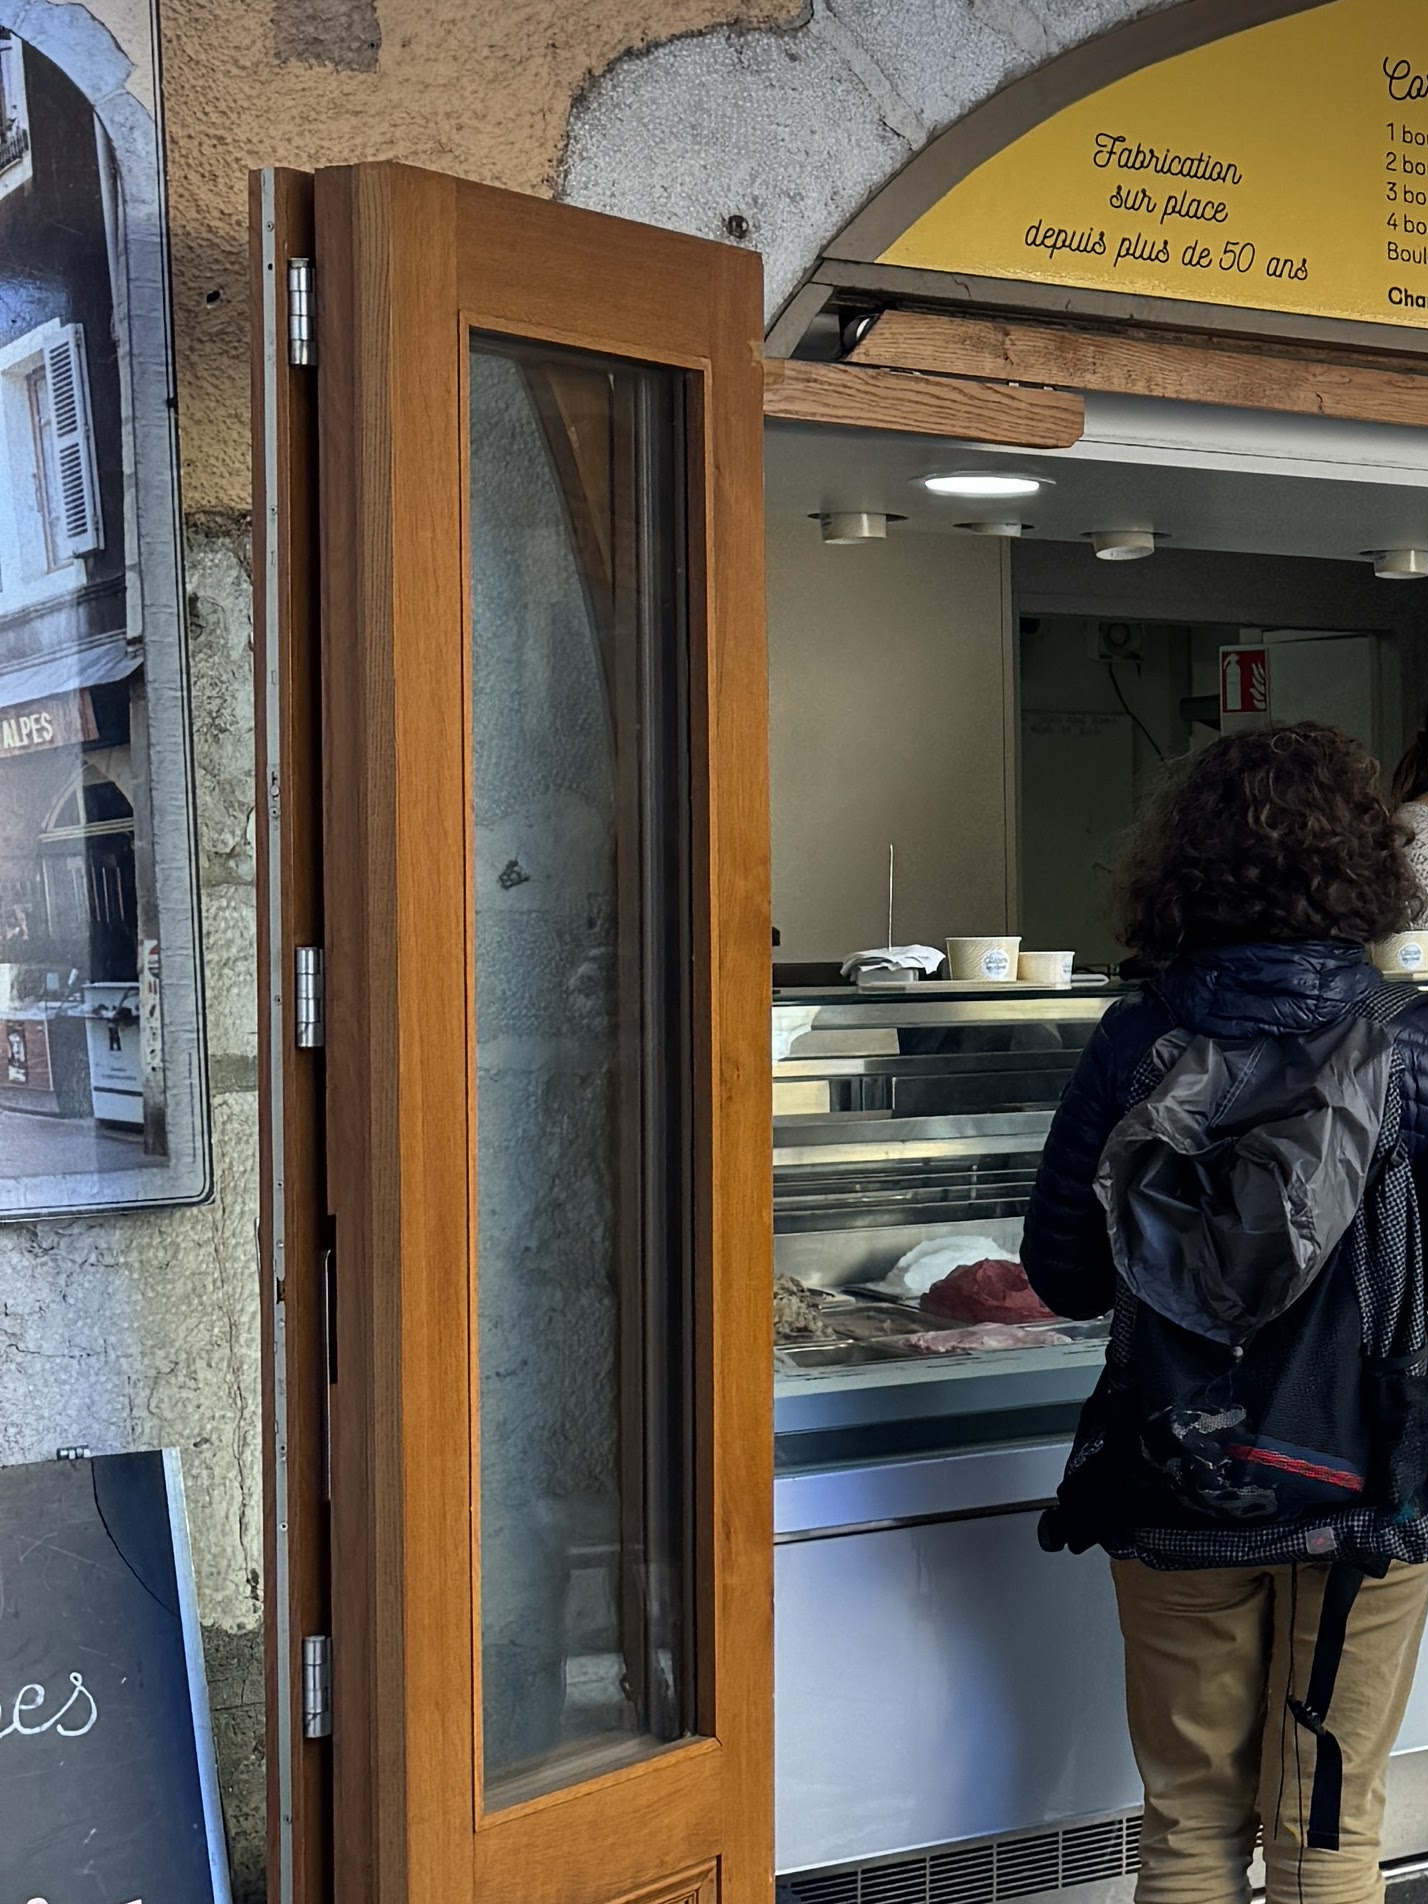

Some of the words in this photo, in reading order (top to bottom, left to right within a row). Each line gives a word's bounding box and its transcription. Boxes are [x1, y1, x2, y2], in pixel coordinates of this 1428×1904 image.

[1387, 123, 1393, 140] 1
[1094, 133, 1242, 184] Fabrication
[1386, 152, 1396, 171] 2
[1110, 185, 1156, 213] sur
[1161, 191, 1228, 224] place
[1387, 182, 1397, 201] 3
[1387, 213, 1397, 230] 4
[1025, 220, 1106, 258] depuis
[1114, 233, 1169, 267] plus
[1182, 240, 1212, 268] de
[1219, 241, 1255, 272] 50
[1267, 257, 1307, 280] ans
[3, 713, 53, 748] ALPES
